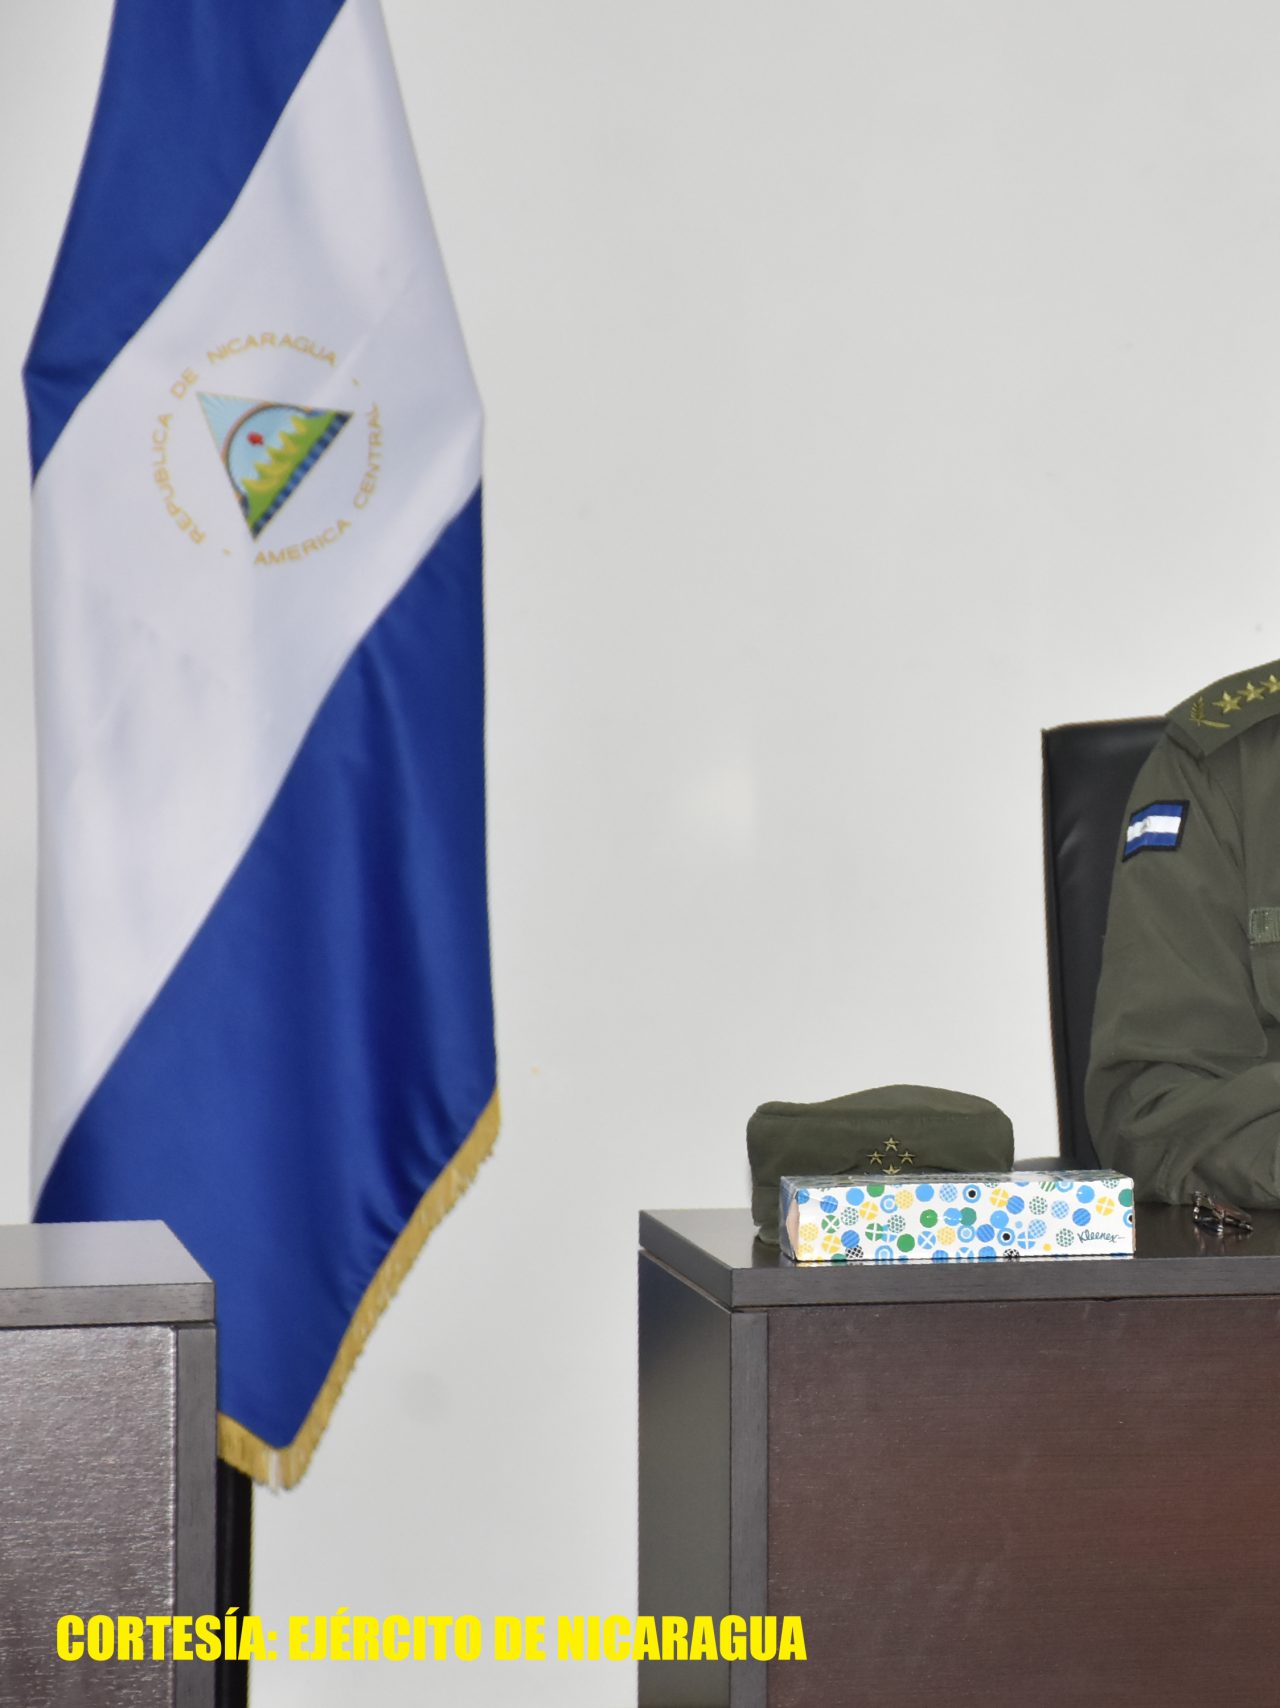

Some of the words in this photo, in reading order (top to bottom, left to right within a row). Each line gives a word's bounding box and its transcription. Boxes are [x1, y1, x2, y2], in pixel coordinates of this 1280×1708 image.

[206, 332, 337, 366] NICARAGUA
[170, 367, 198, 400] DE
[152, 413, 206, 545] REPUBLICA
[253, 518, 351, 566] AMERICA
[352, 402, 384, 510] CENTRAL
[1077, 1229, 1119, 1244] Kleenex
